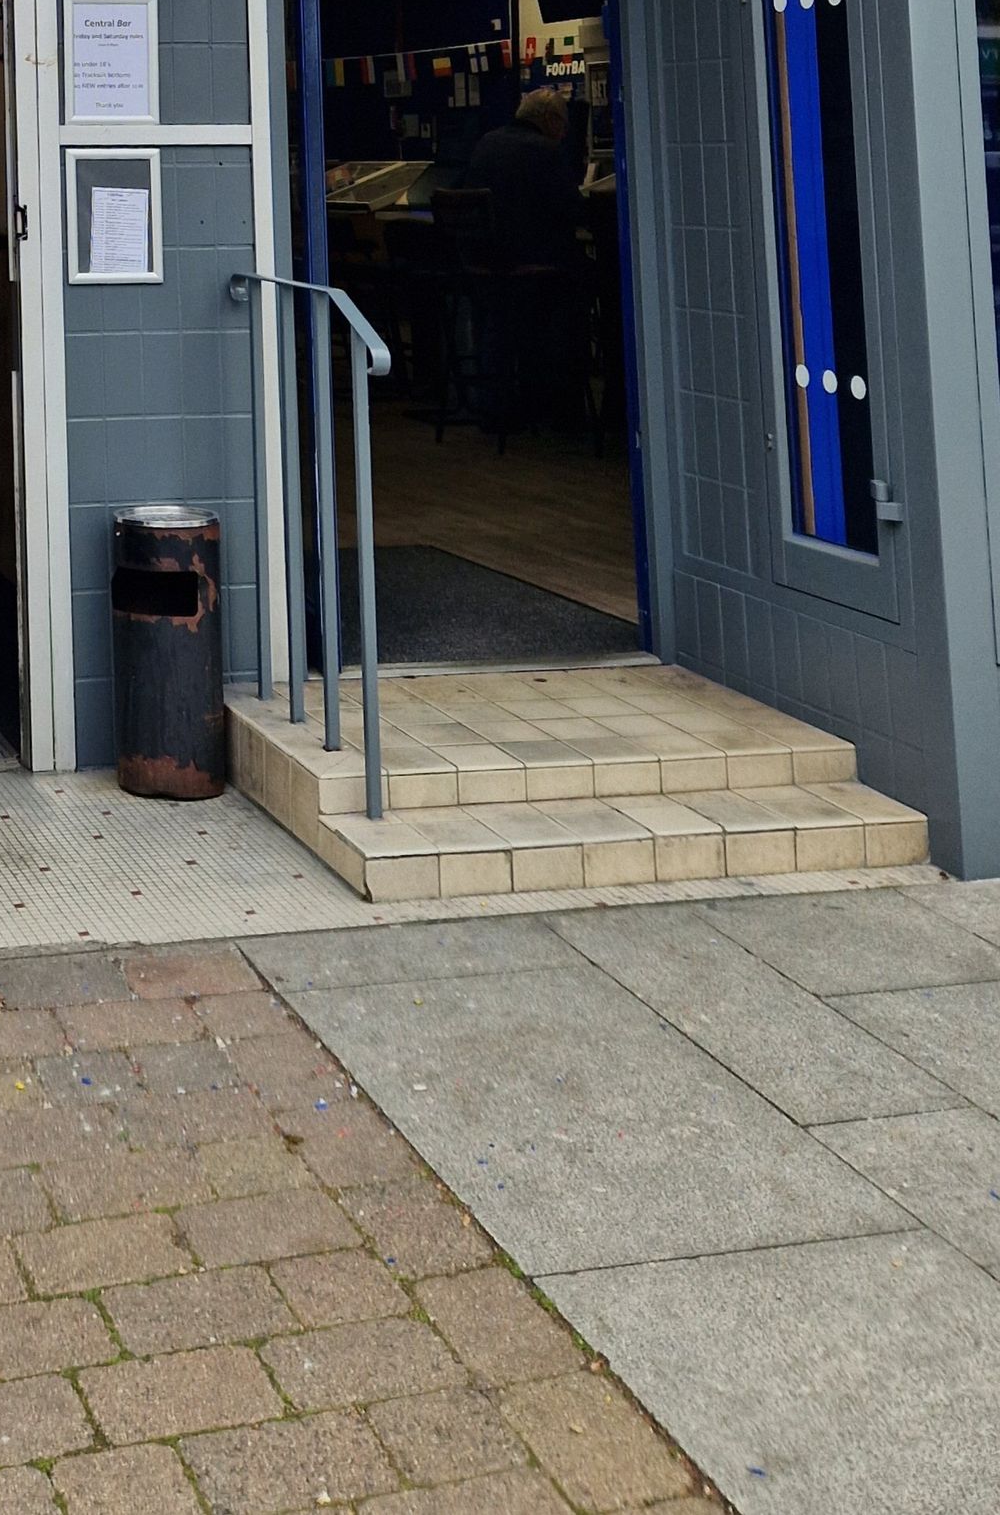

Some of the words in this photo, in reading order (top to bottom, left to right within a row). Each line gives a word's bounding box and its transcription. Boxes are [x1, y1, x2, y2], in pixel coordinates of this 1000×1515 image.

[84, 19, 115, 27] Central
[117, 19, 132, 27] Bar
[546, 60, 586, 77] FOOTBA
